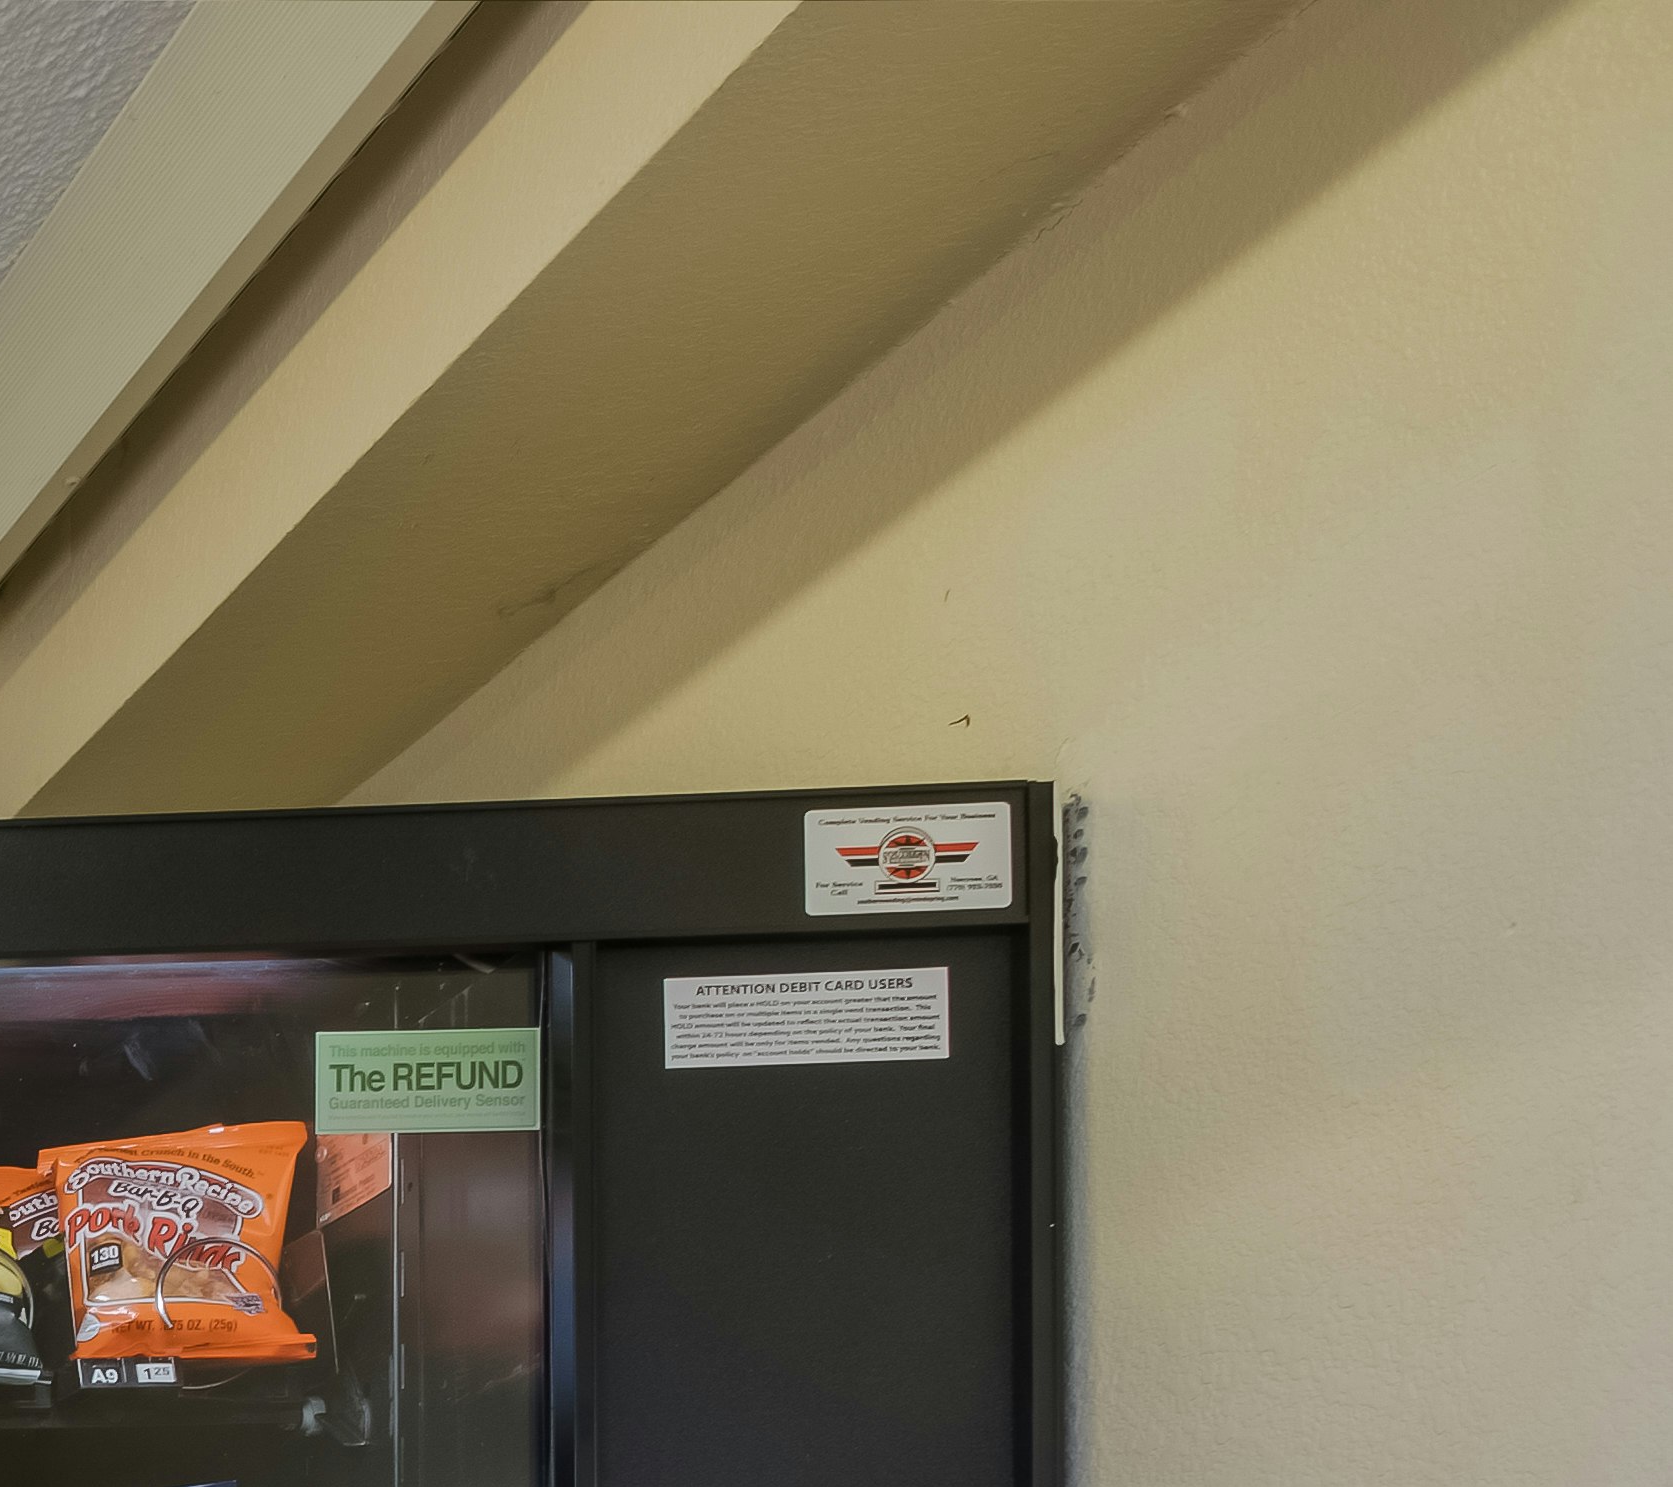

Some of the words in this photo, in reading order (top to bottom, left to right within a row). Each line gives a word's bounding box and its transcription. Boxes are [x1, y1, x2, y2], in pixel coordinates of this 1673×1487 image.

[696, 982, 776, 996] ATTENTION
[780, 981, 821, 993] DEBIT
[825, 979, 864, 992] CARD
[868, 977, 913, 989] USERS
[330, 1044, 357, 1057] This
[360, 1043, 416, 1057] machine
[419, 1043, 430, 1055] is
[434, 1042, 495, 1058] equipped
[498, 1041, 525, 1054] with
[329, 1063, 386, 1093] The
[392, 1059, 524, 1092] REFUND
[330, 1096, 410, 1110] Guaranteed
[414, 1095, 471, 1110] Delivery
[475, 1094, 525, 1108] Sensor
[67, 1162, 176, 1190] Southern
[176, 1168, 256, 1215] Recipe
[113, 1181, 200, 1218] Bar-B-Q
[68, 1205, 141, 1250] Pork
[90, 1244, 119, 1264] 130
[91, 1368, 119, 1384] A9
